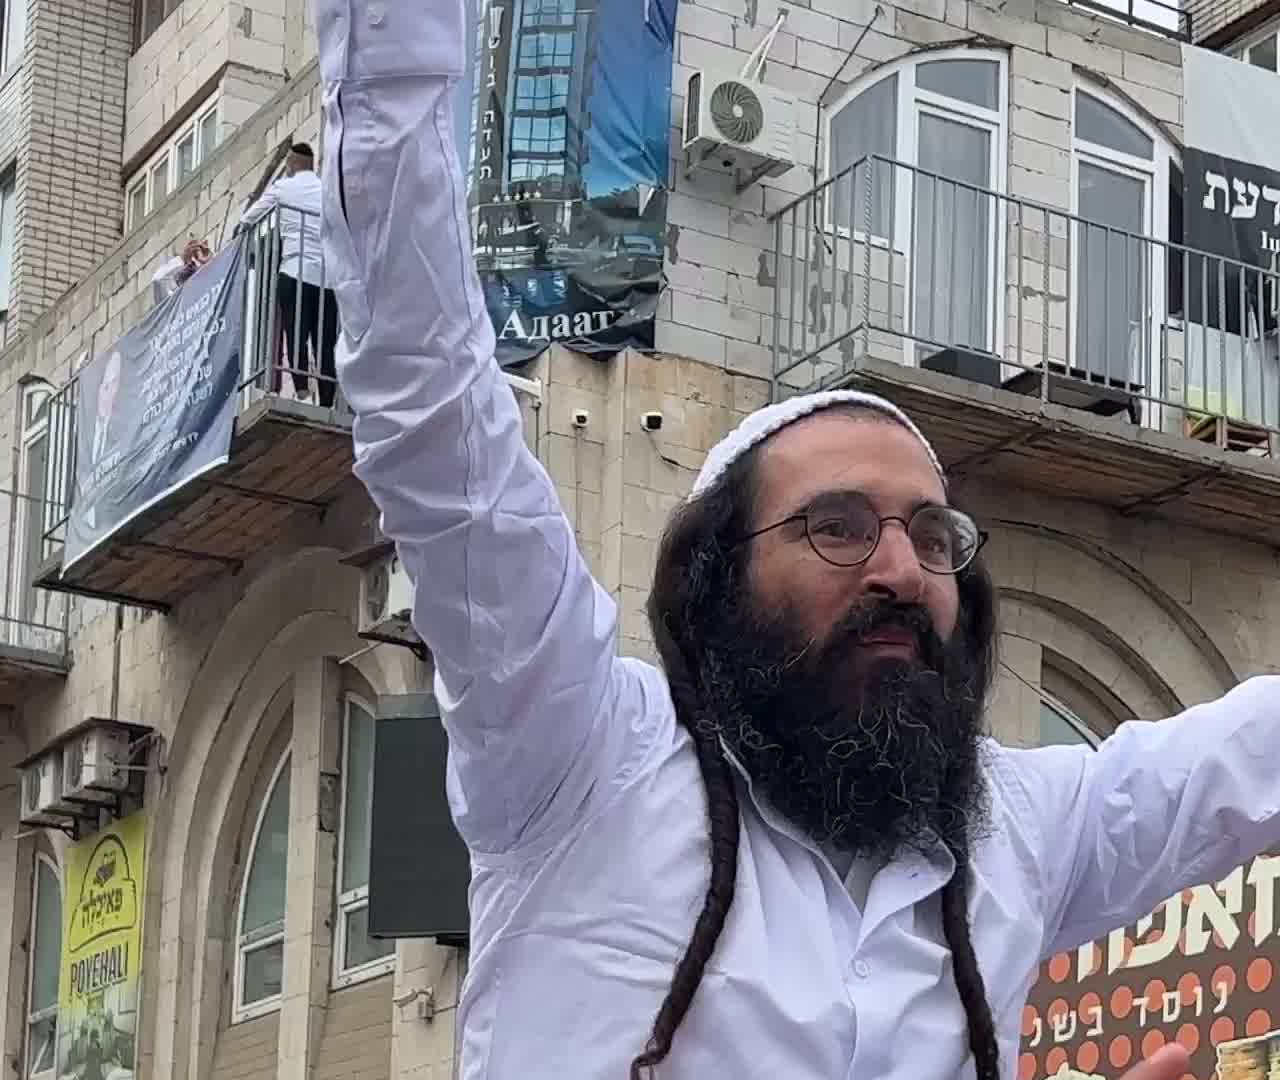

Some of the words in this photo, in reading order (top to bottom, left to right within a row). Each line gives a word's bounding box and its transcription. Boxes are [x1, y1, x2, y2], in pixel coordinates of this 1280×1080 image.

[497, 309, 615, 343] Адаат
[70, 941, 129, 996] POYEHALI
[1131, 981, 1228, 1027] נוסד
